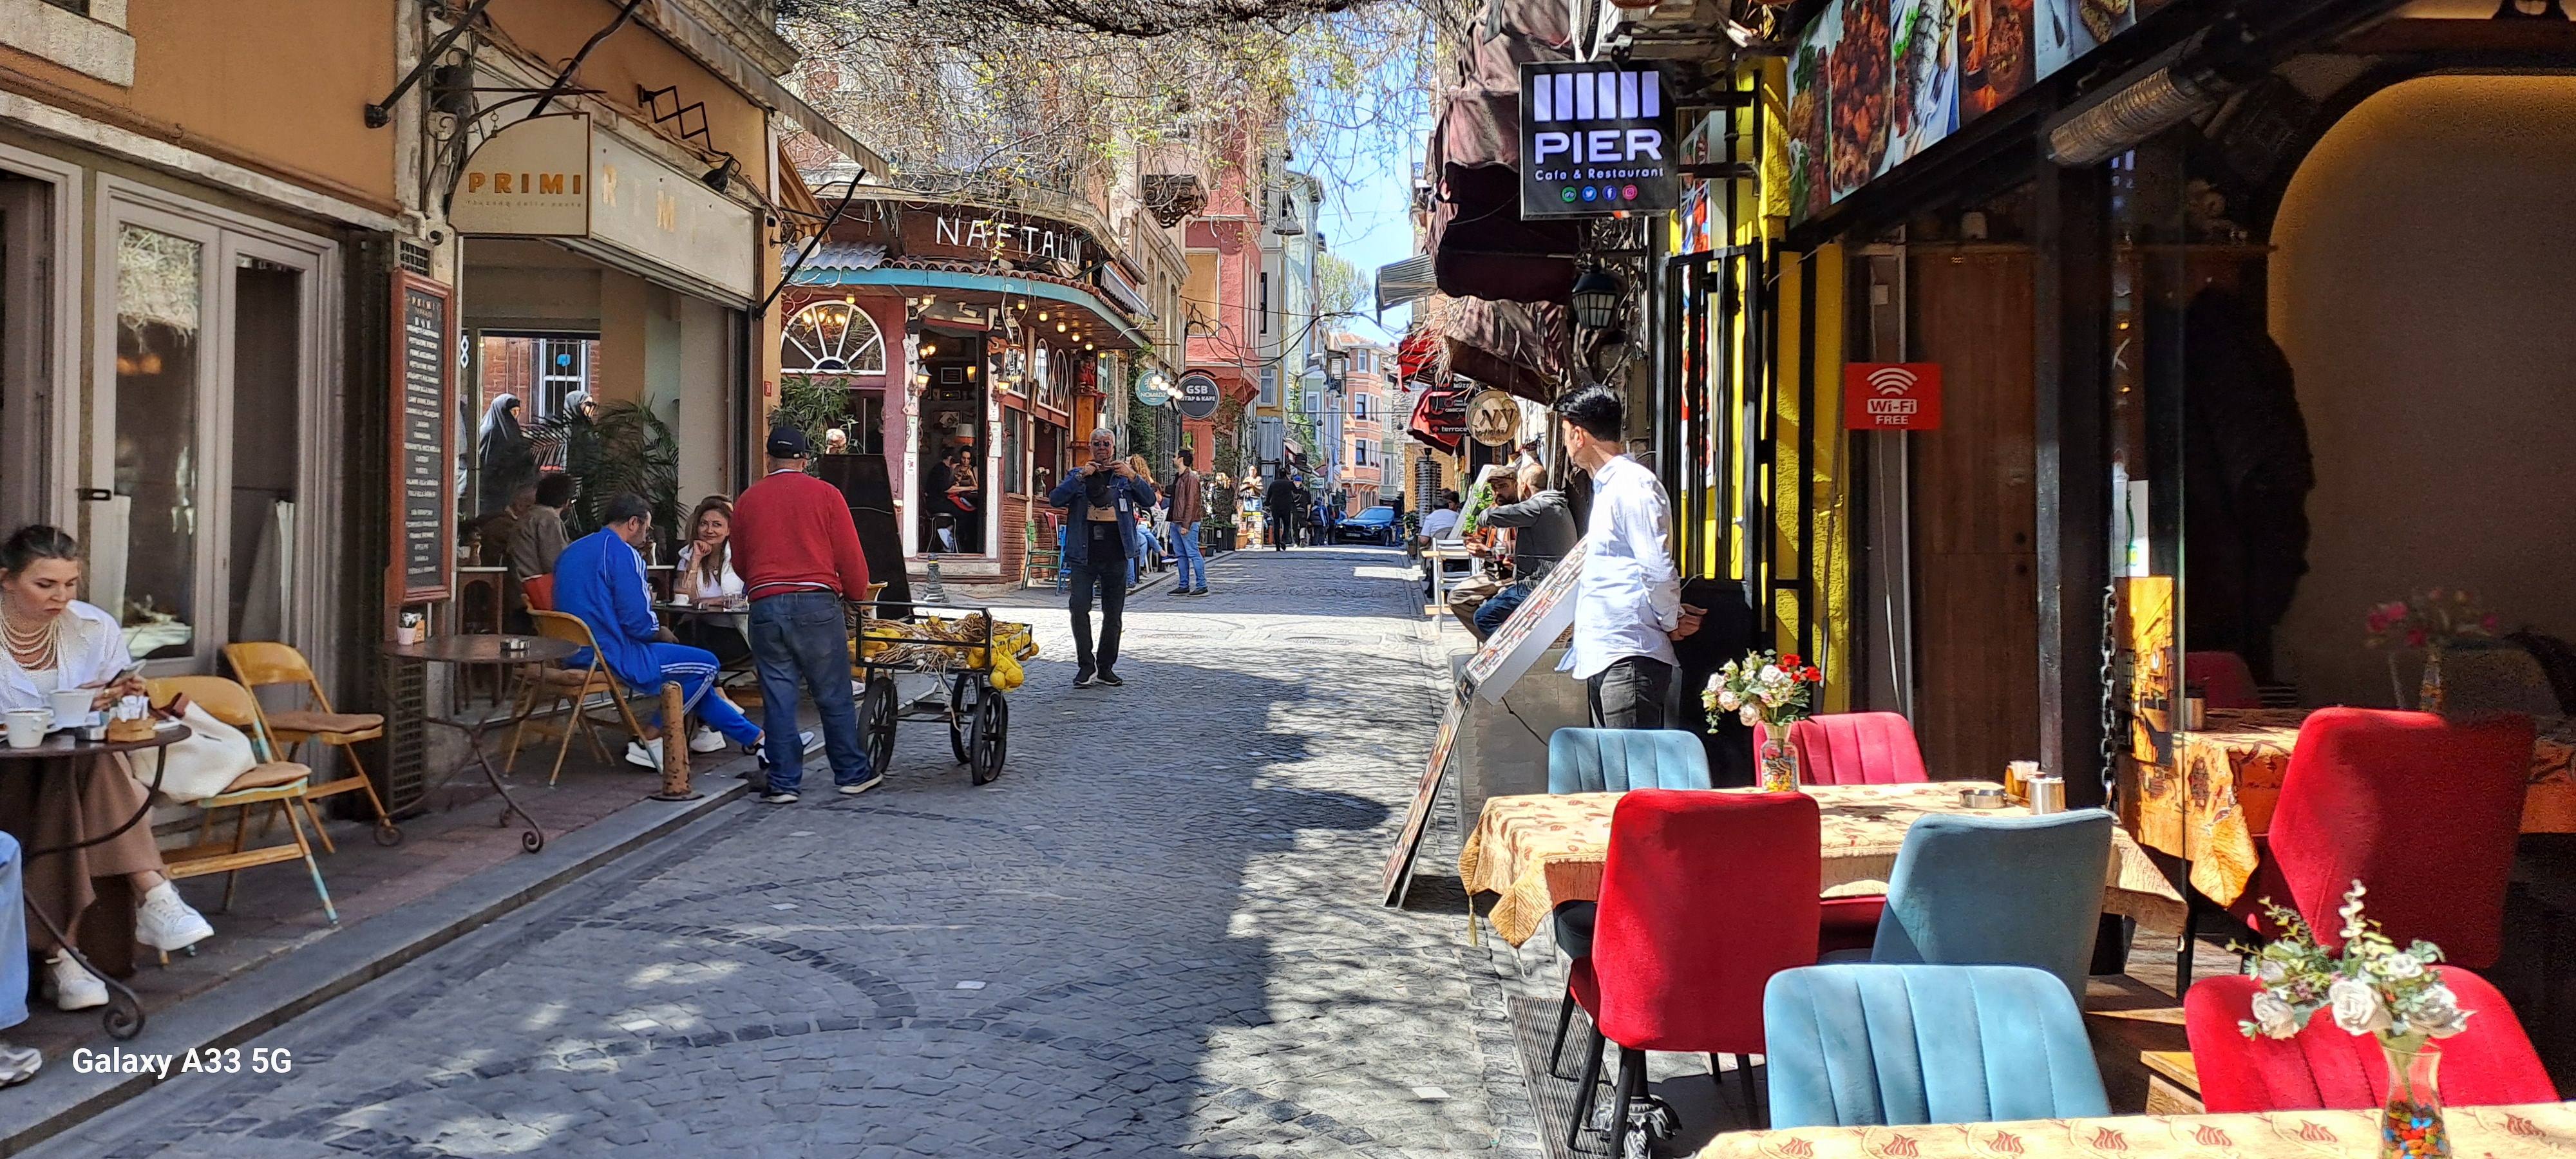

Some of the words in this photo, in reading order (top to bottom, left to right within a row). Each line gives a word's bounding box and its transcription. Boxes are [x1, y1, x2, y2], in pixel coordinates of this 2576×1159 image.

[1535, 129, 1663, 164] PIER
[1535, 169, 1567, 181] Cafe
[1573, 168, 1582, 180] &
[1588, 167, 1663, 180] Restaurant
[468, 172, 581, 194] PRIMI
[936, 216, 1082, 266] NAFTALIN
[1186, 385, 1208, 394] GSB
[1870, 400, 1914, 412] Wi-Fi
[1875, 415, 1909, 425] FREE
